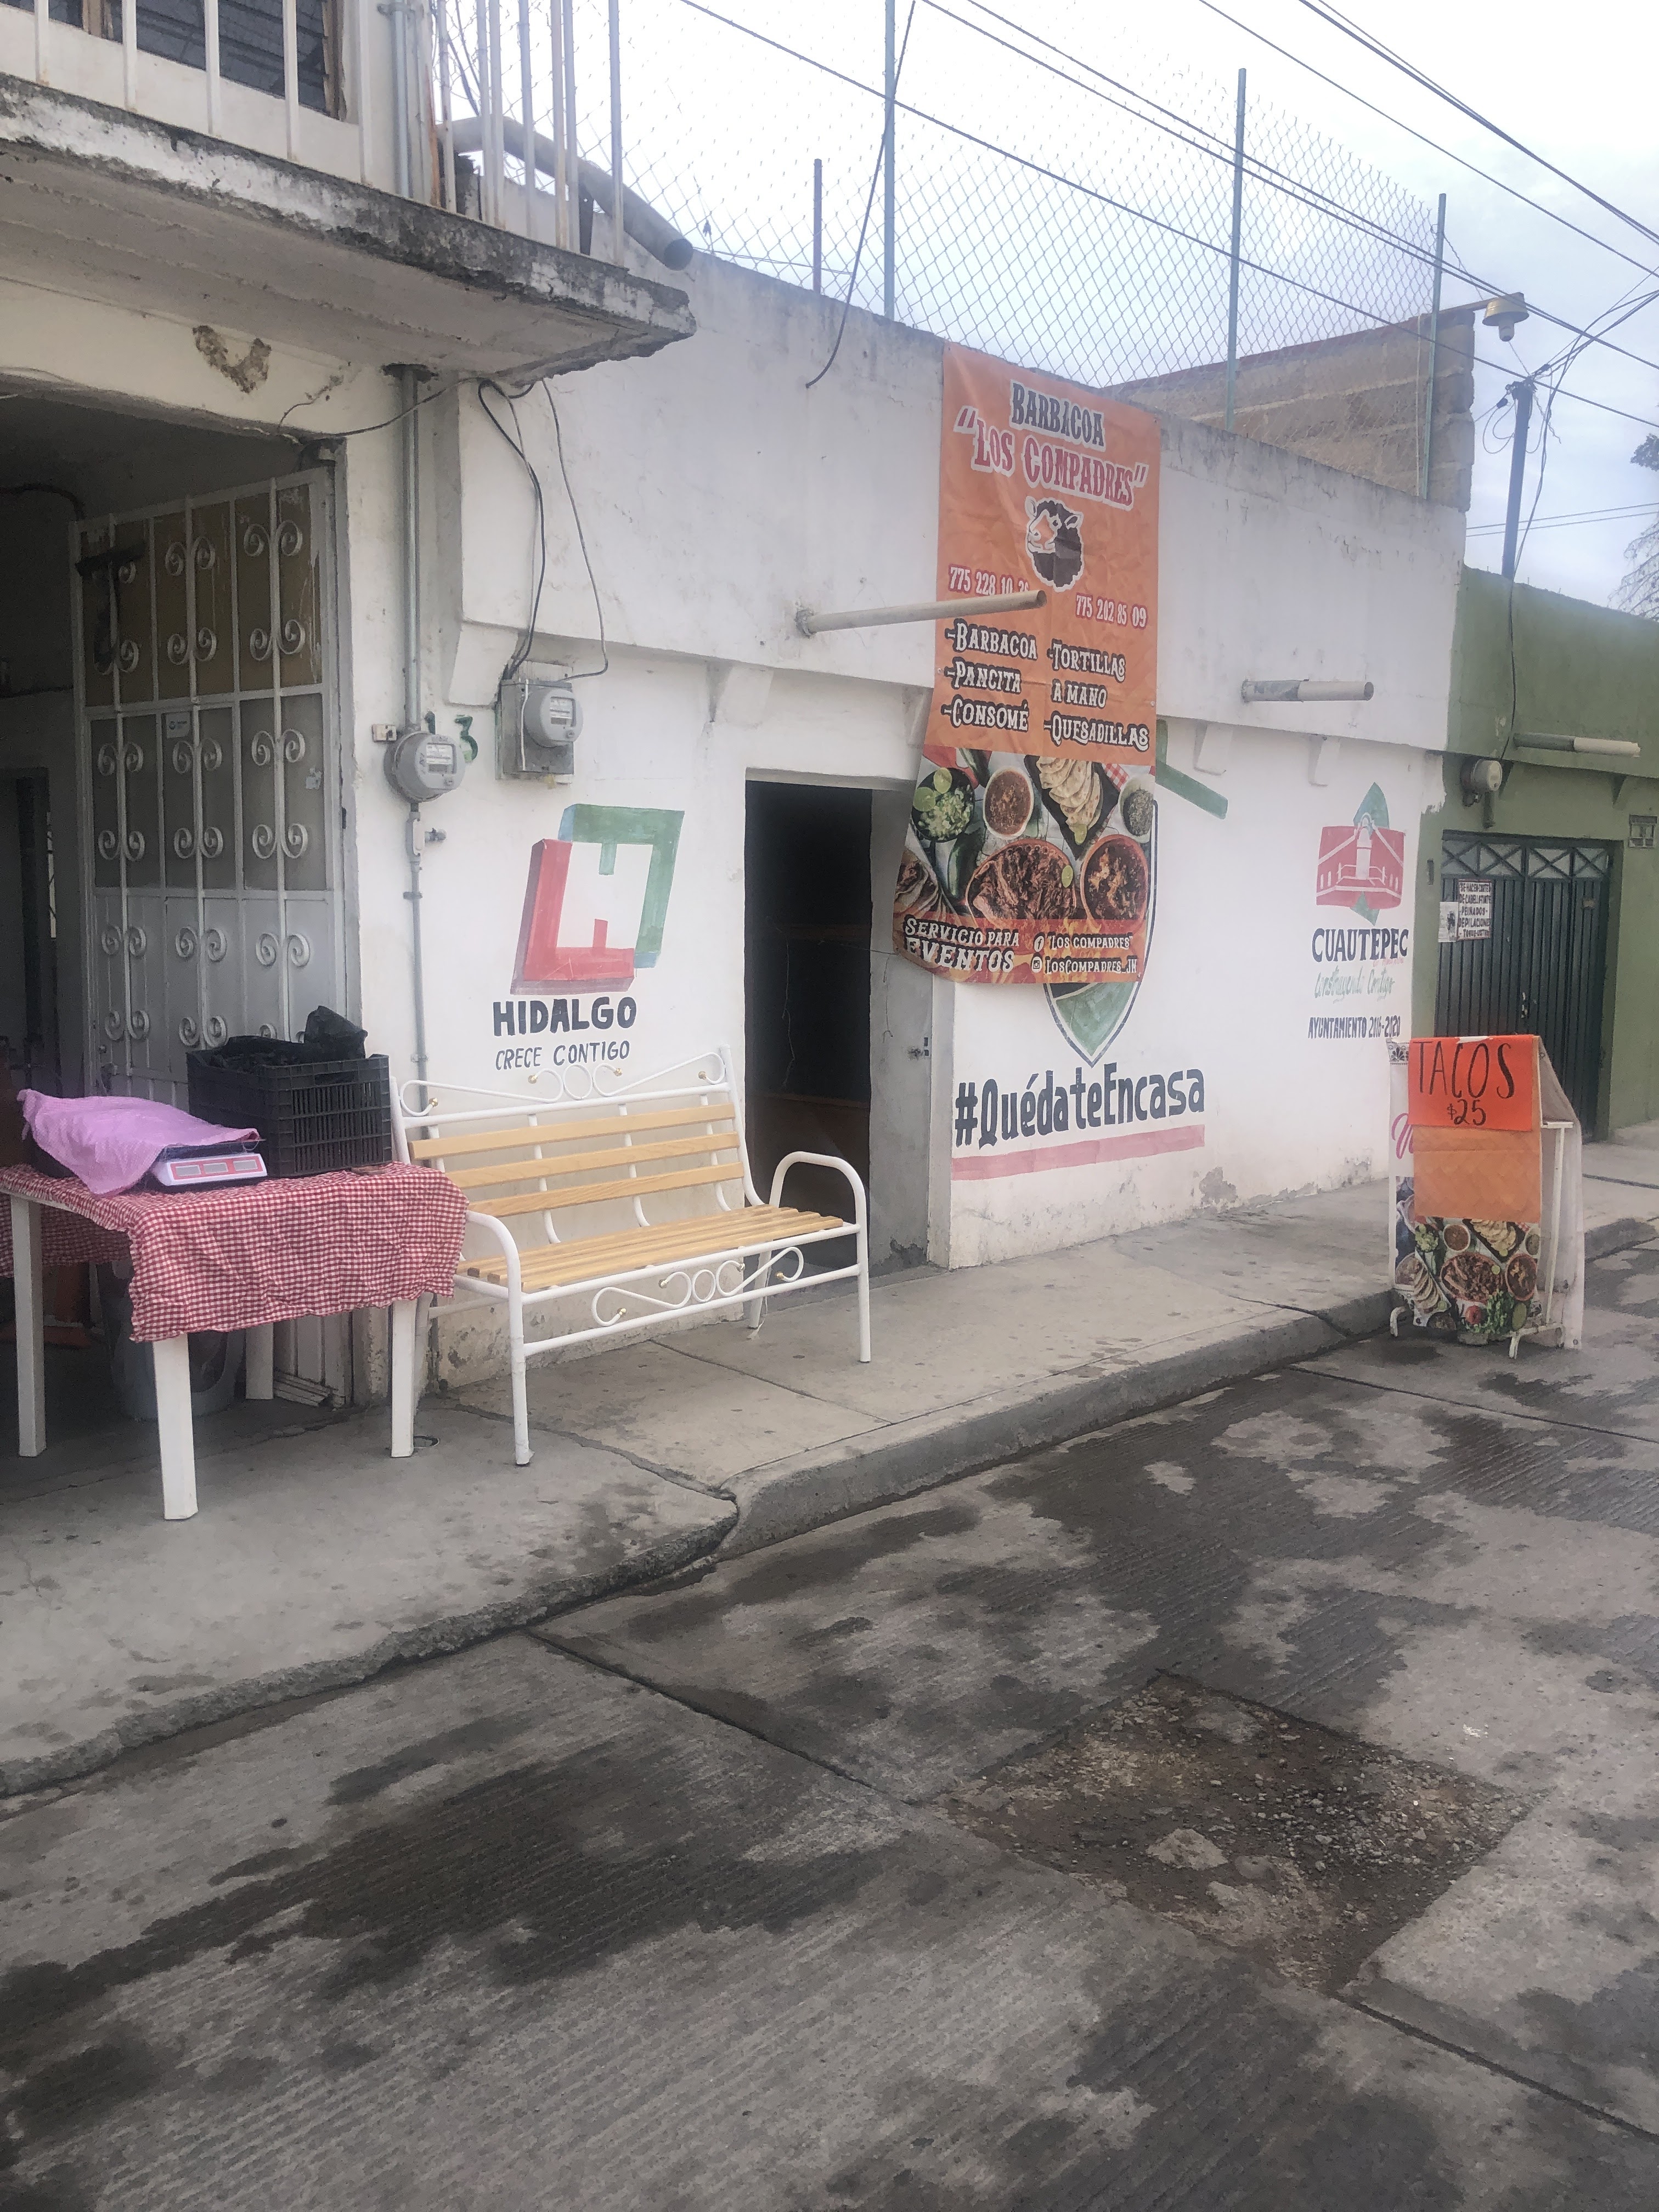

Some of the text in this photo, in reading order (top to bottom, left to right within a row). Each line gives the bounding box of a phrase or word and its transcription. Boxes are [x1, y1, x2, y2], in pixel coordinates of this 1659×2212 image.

[1012, 383, 1104, 447] BARBACOA
[950, 567, 970, 591] 775
[975, 571, 996, 596] 228
[1001, 577, 1013, 595] 10
[1076, 595, 1147, 628] 775 202 85 09
[1053, 682, 1107, 708] A MANO
[905, 918, 1019, 947] SERVICIO PARA
[1312, 928, 1409, 963] CUAUTEPEC
[905, 936, 1015, 973] EVENTOS
[493, 996, 637, 1037] HIDALGO
[1307, 1017, 1367, 1039] AYUNTAMIENTO
[495, 1040, 630, 1070] CRECE CONTIGO
[1412, 1040, 1515, 1099] TACOS
[1447, 1098, 1487, 1126] $25
